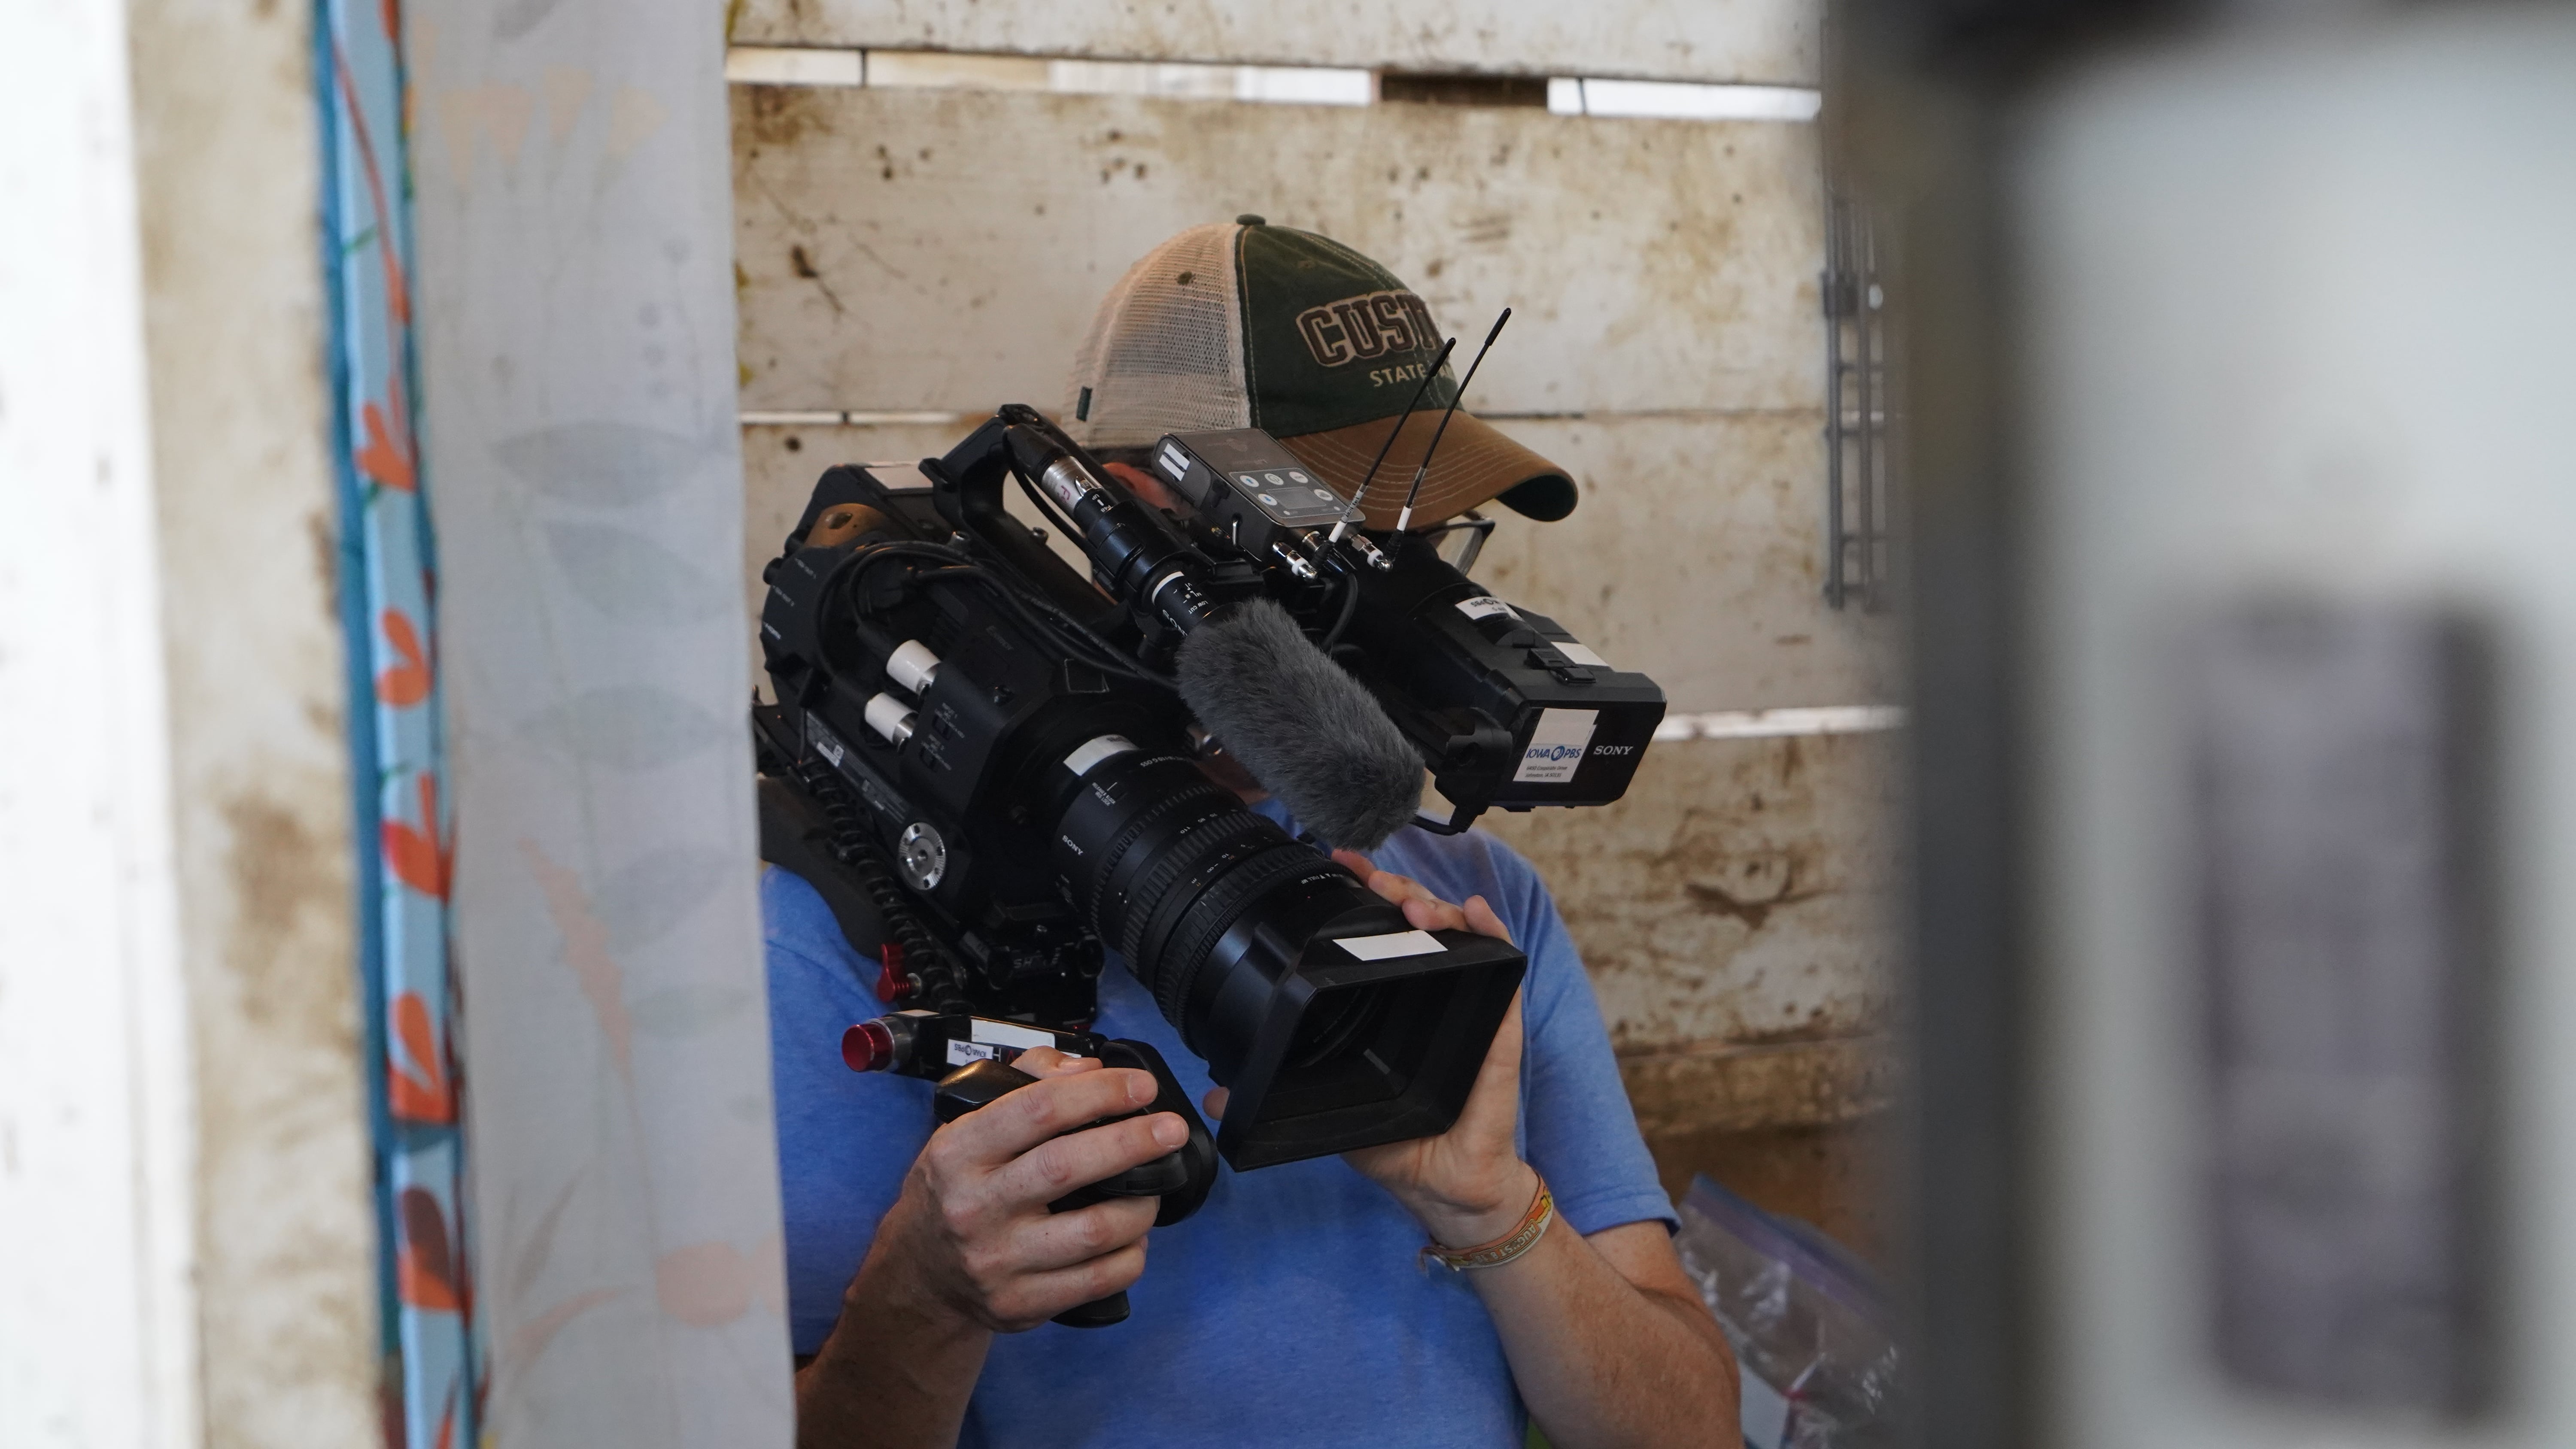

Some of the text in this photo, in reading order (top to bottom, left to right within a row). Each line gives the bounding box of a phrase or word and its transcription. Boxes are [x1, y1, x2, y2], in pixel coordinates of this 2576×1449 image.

[1370, 364, 1426, 387] STATE
[1188, 605, 1198, 614] CUT
[1525, 748, 1582, 758] IOWA PBS
[1593, 745, 1633, 755] SONY
[1061, 834, 1084, 857] SONY
